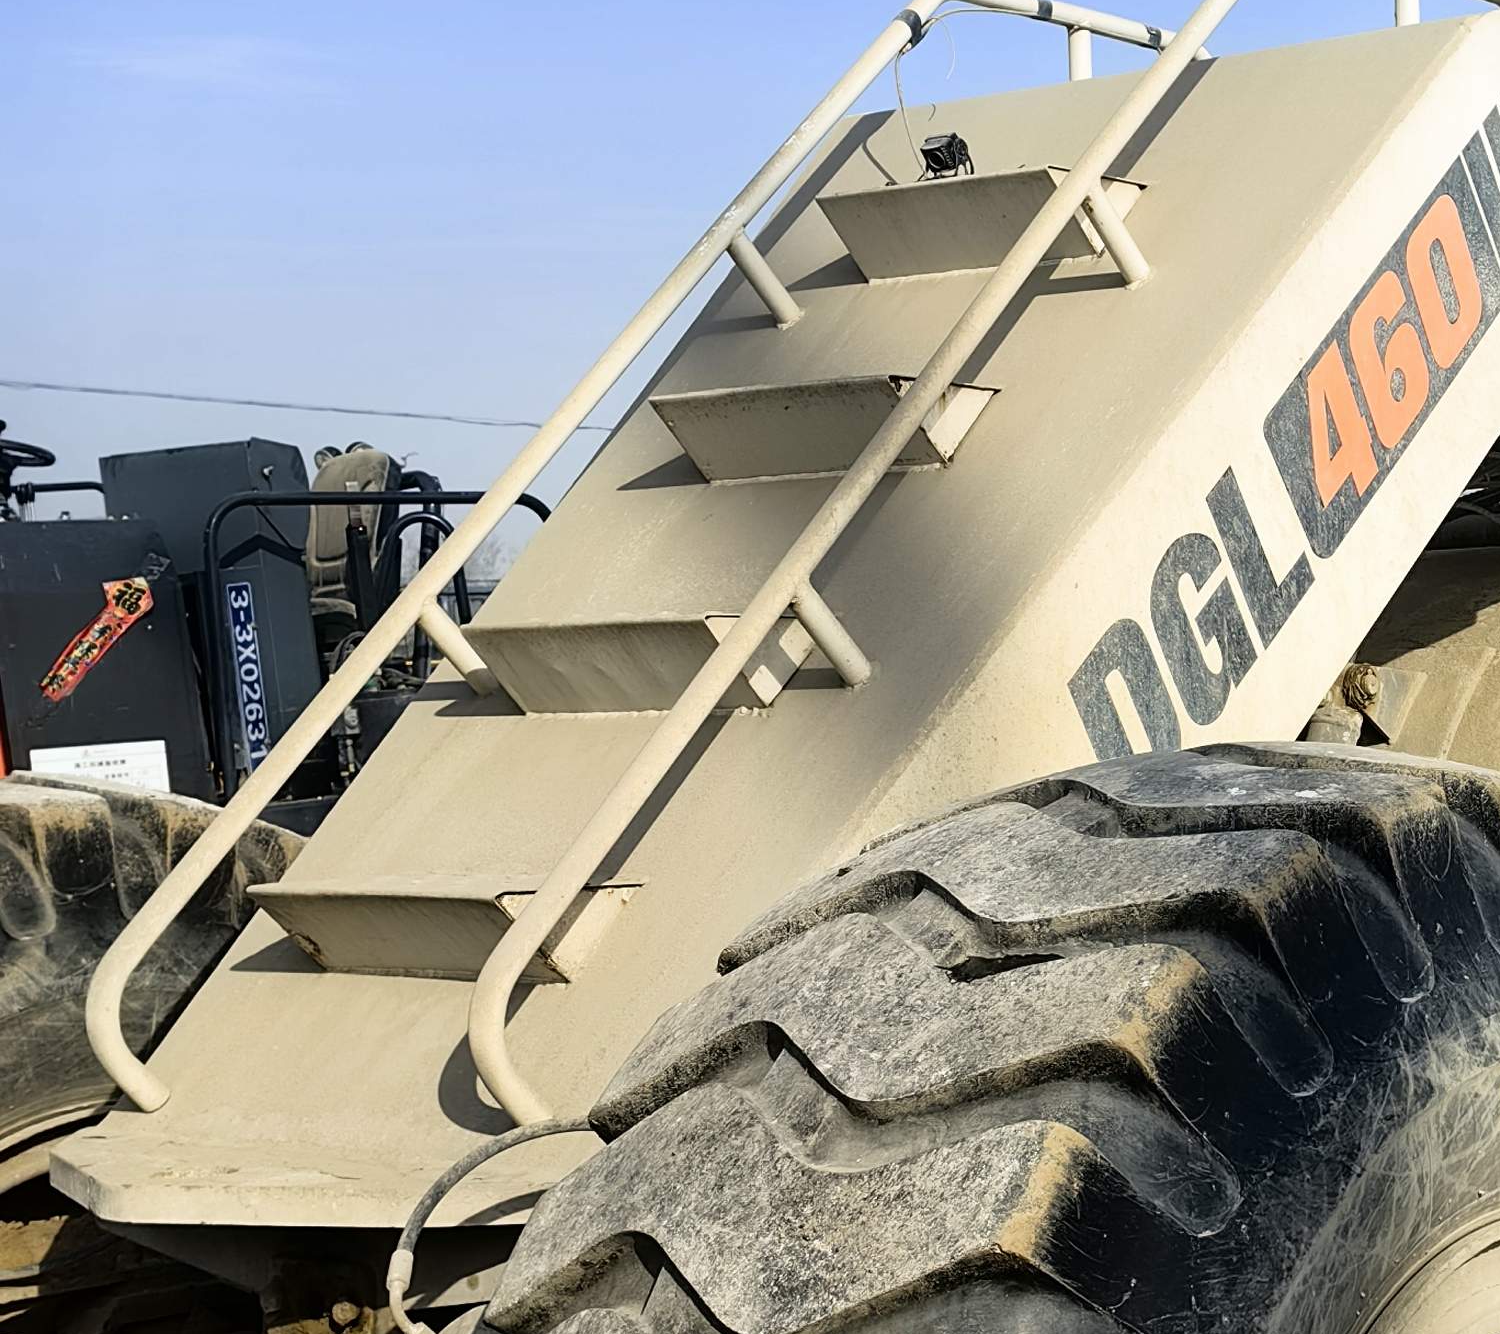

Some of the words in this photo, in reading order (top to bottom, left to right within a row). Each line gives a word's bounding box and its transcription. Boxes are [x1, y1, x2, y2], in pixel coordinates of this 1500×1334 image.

[1066, 464, 1316, 760] DGL
[1305, 192, 1483, 509] 460
[230, 589, 268, 760] 3-3X02631
